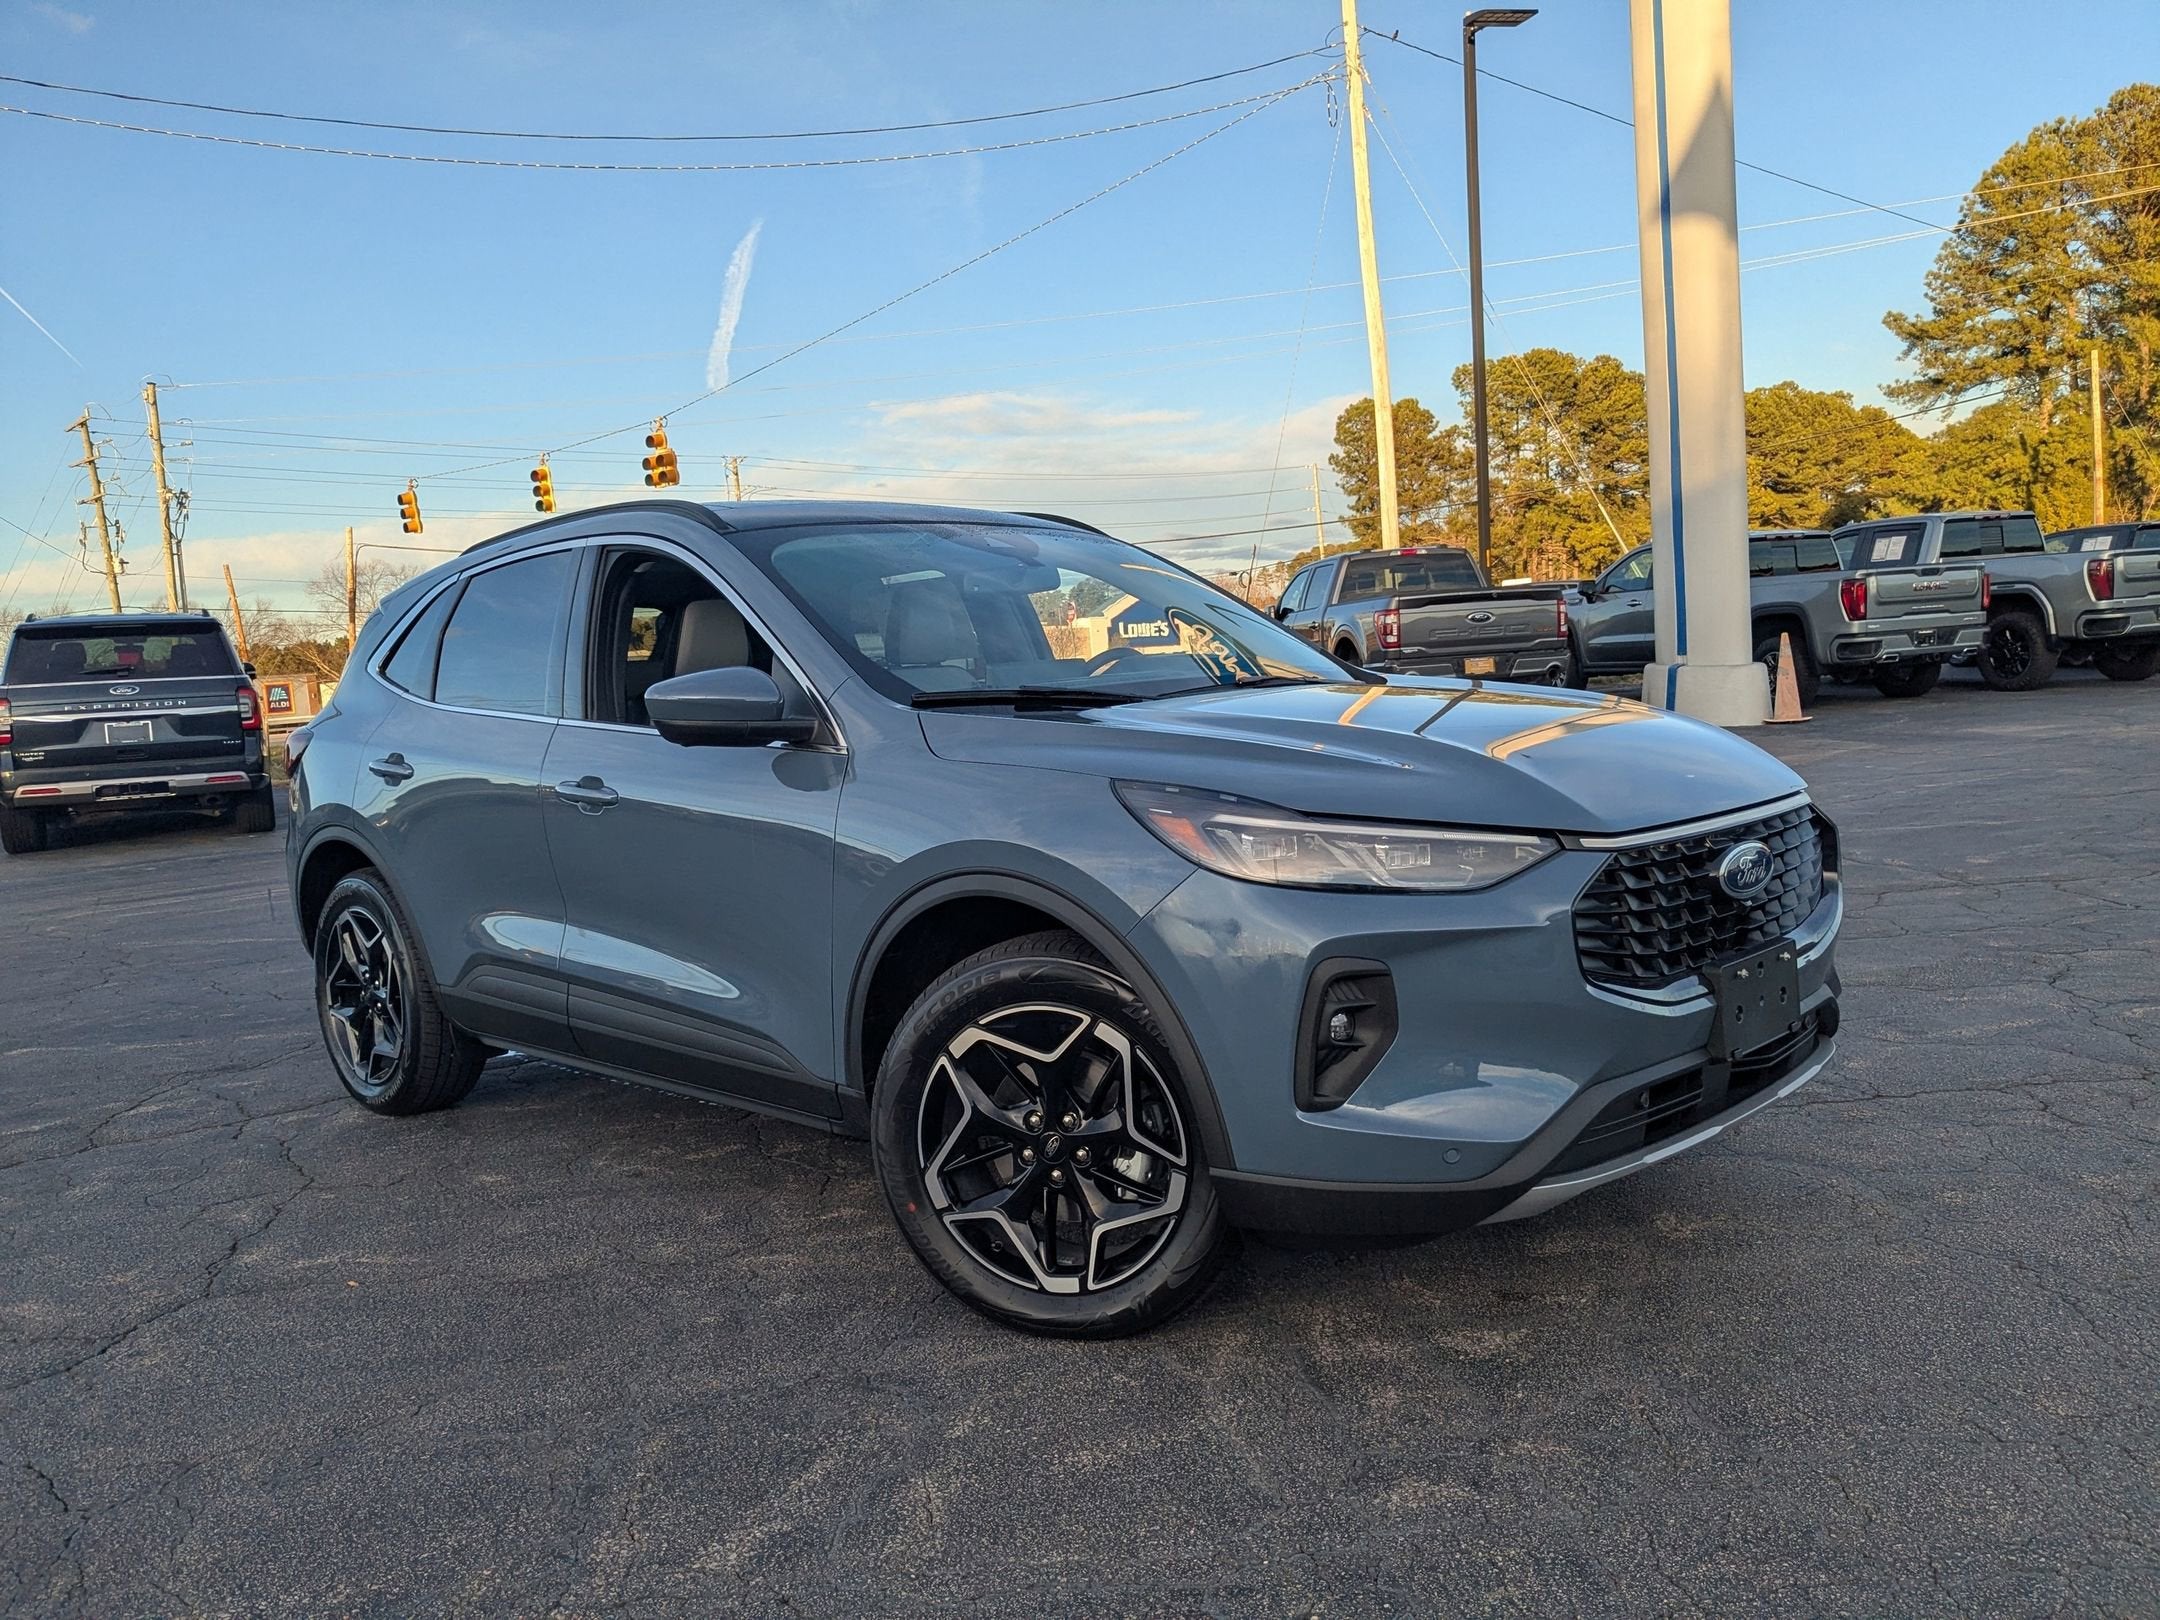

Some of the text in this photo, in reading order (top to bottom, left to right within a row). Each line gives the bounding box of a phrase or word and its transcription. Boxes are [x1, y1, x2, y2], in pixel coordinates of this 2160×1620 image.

[1118, 620, 1170, 638] LOWE'S
[64, 700, 187, 711] EXPEDITION
[270, 701, 290, 709] ALDI
[1737, 854, 1767, 886] Ford
